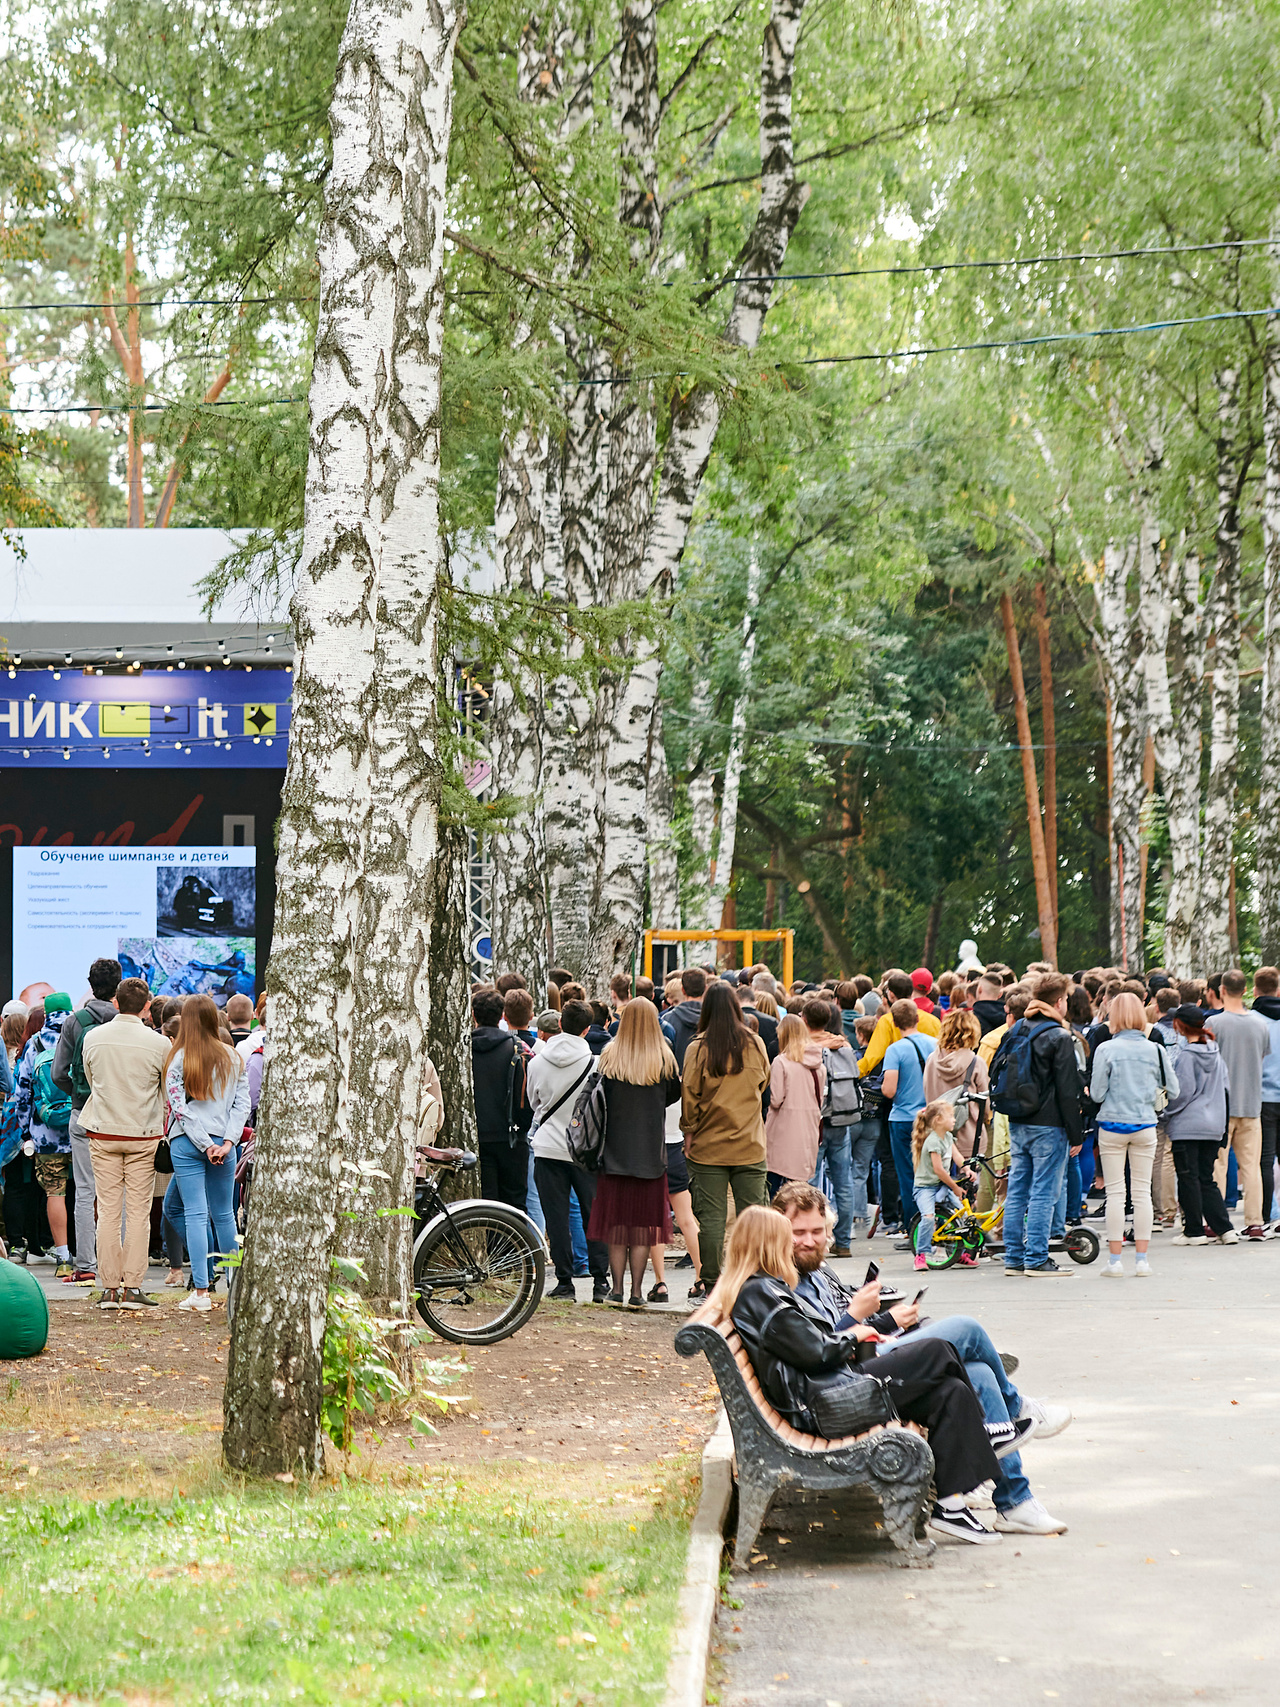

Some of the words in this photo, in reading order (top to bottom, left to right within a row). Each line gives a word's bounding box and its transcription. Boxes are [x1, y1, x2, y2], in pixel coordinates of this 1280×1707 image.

[197, 697, 229, 738] it
[40, 850, 105, 864] Обучение
[108, 852, 175, 863] шимпанзе
[179, 852, 188, 862] и
[190, 850, 229, 864] детей
